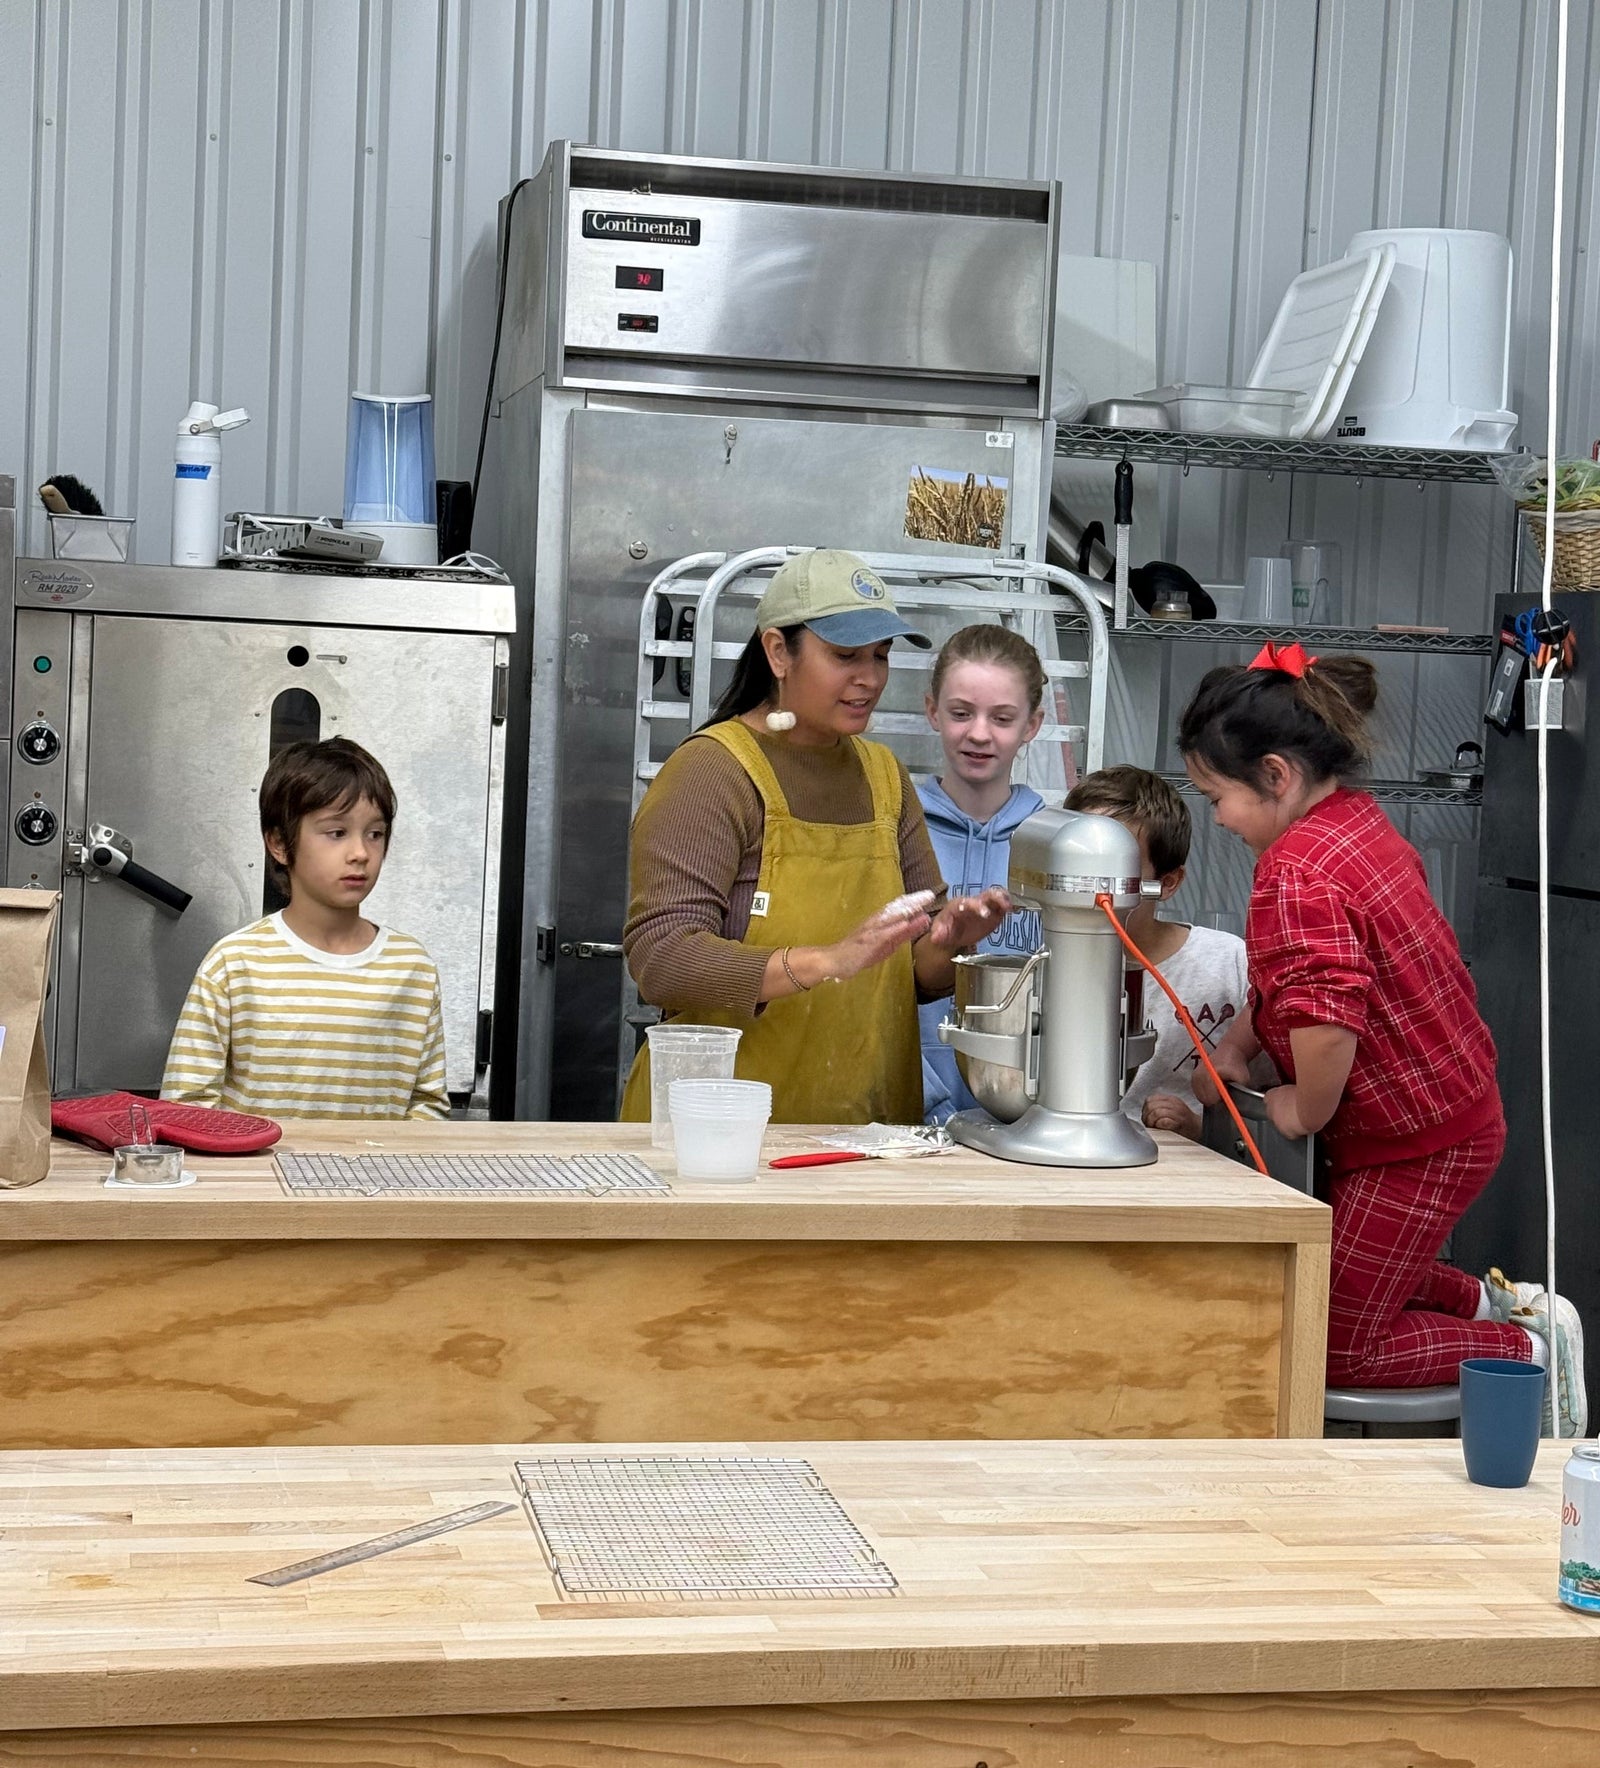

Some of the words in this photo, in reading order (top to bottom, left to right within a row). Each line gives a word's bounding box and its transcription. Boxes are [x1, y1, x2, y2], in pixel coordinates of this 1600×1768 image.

[592, 211, 691, 237] Continental
[1337, 427, 1366, 437] BRUTE
[37, 583, 54, 592] RM
[54, 585, 79, 593] 2020
